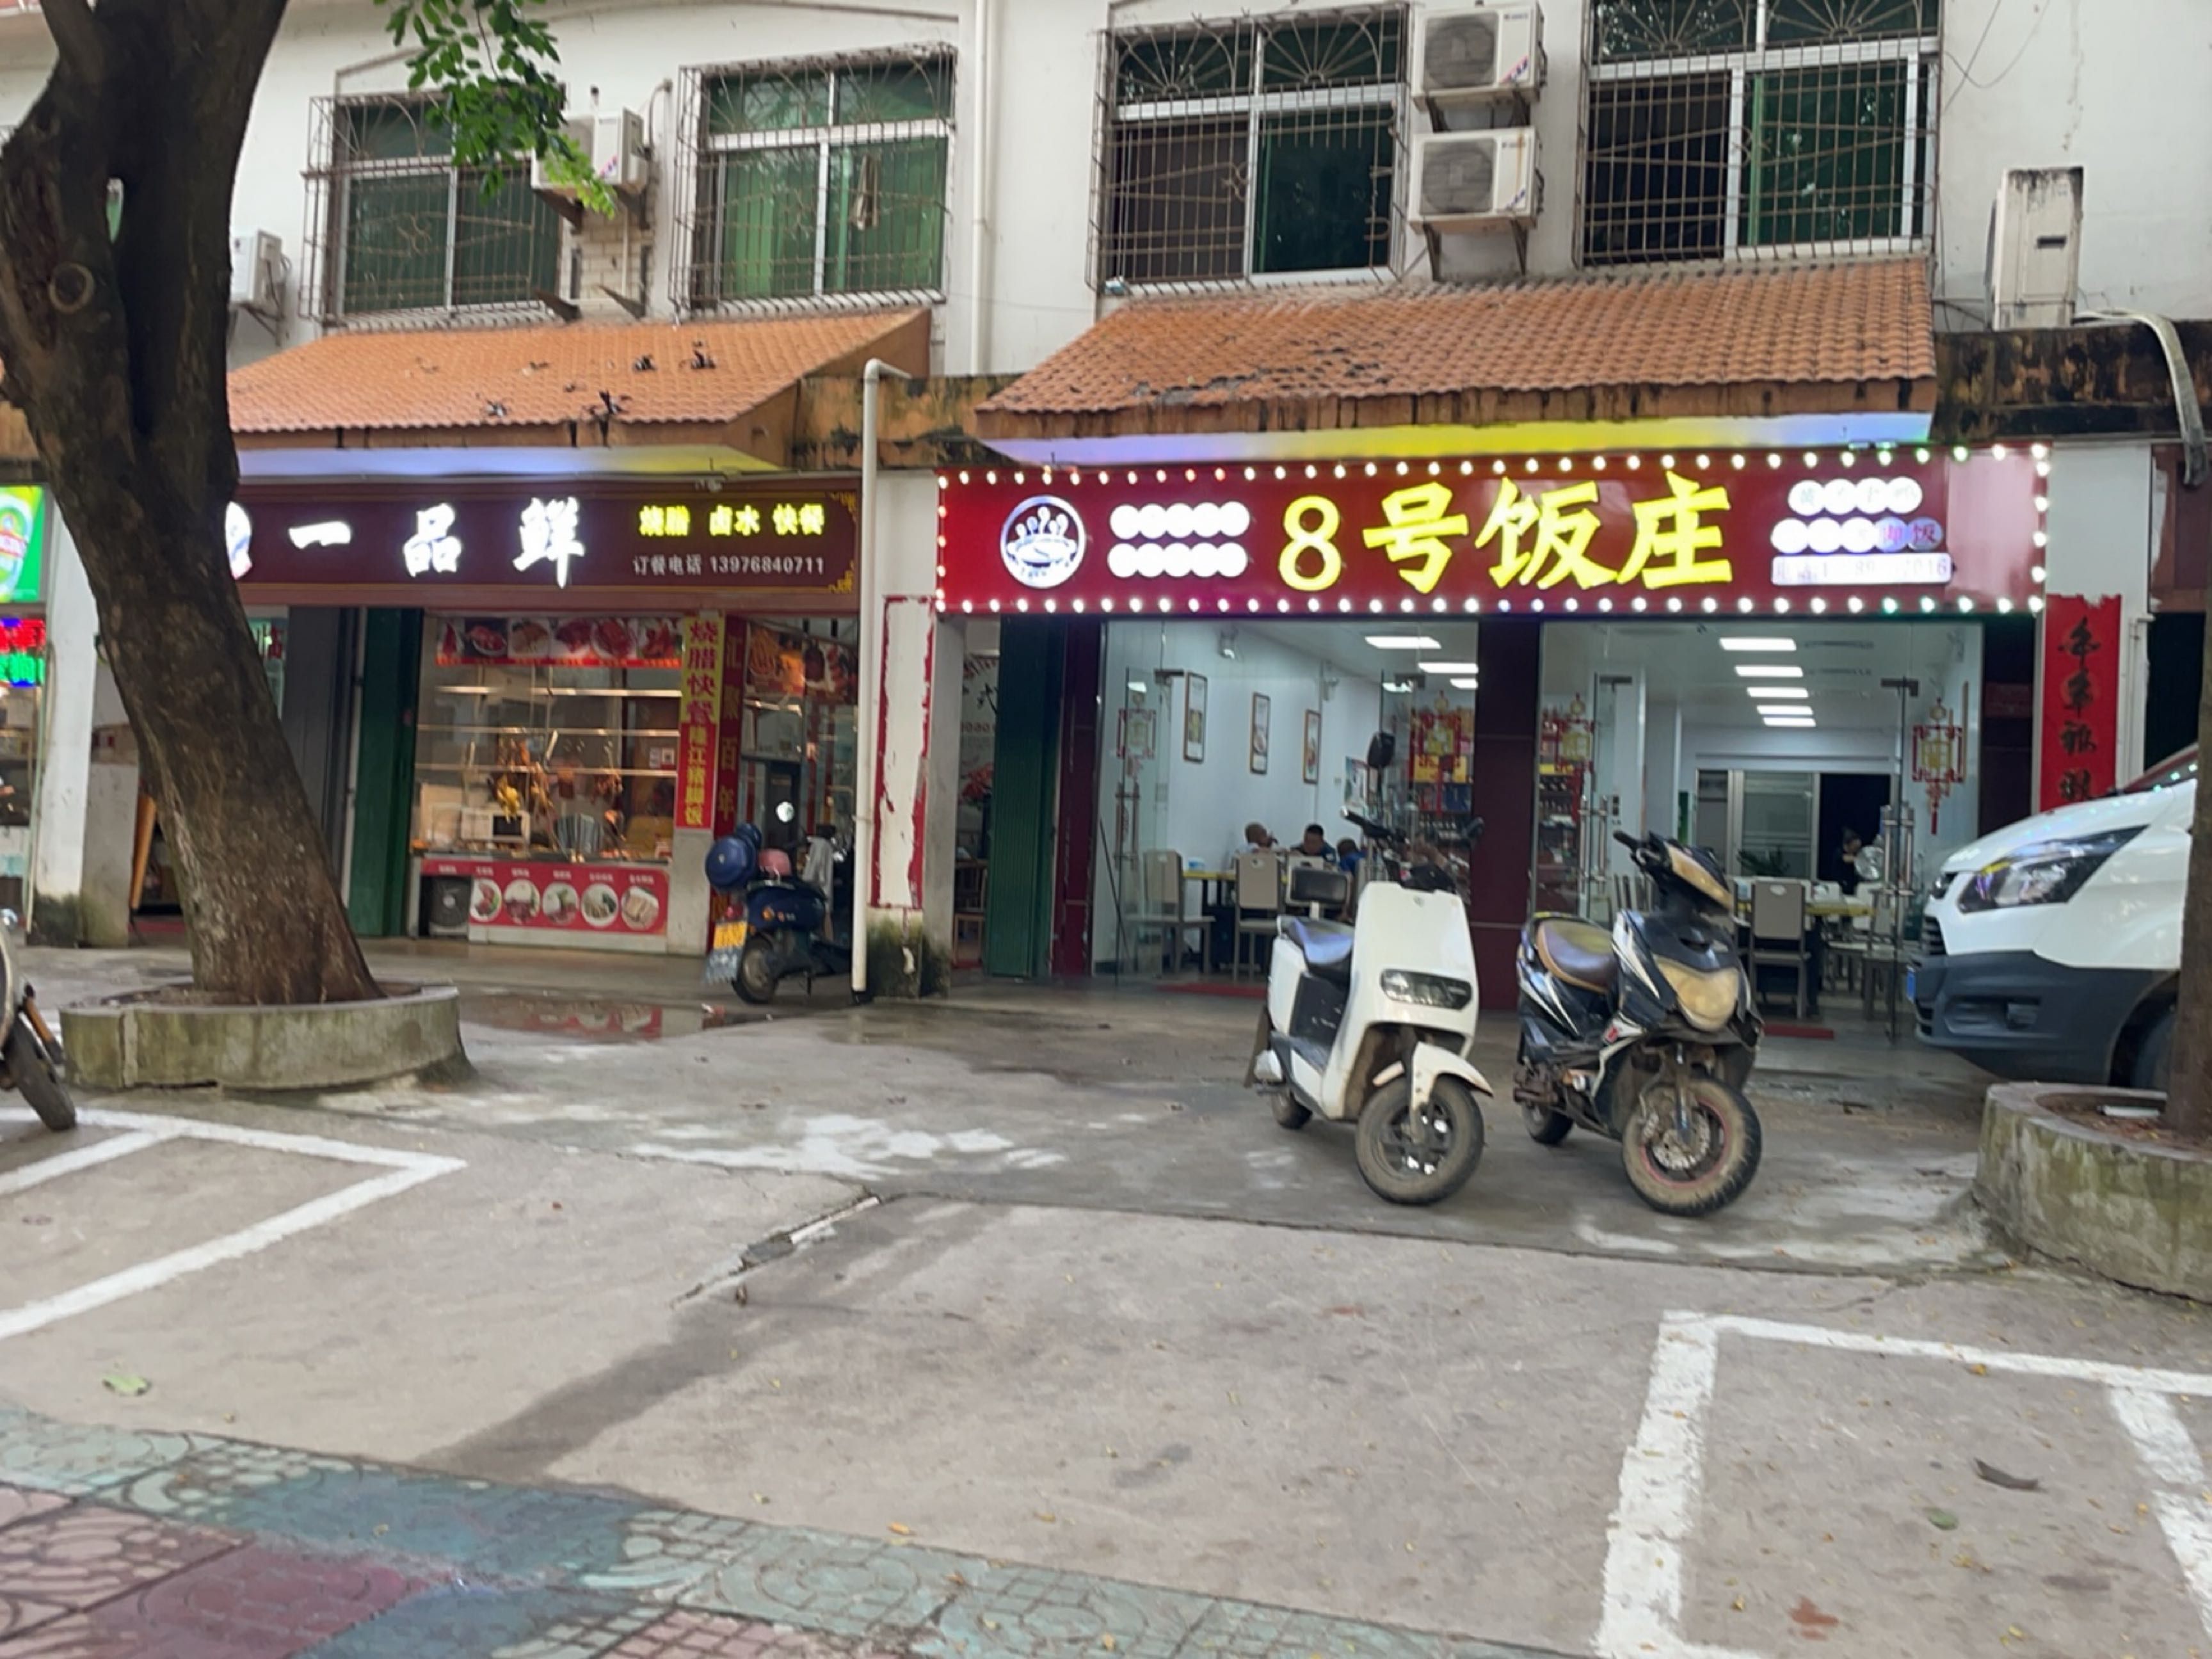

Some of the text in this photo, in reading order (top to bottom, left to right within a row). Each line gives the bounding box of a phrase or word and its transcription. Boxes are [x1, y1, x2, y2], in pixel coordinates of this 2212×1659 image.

[289, 497, 585, 589] 一品鲜
[632, 554, 824, 575] 订餐电话 13976840711
[709, 504, 760, 536] 卤水
[773, 503, 824, 535] 快餐
[1279, 471, 1732, 593] 8号饭庄
[686, 619, 719, 725] 烧腊快餐
